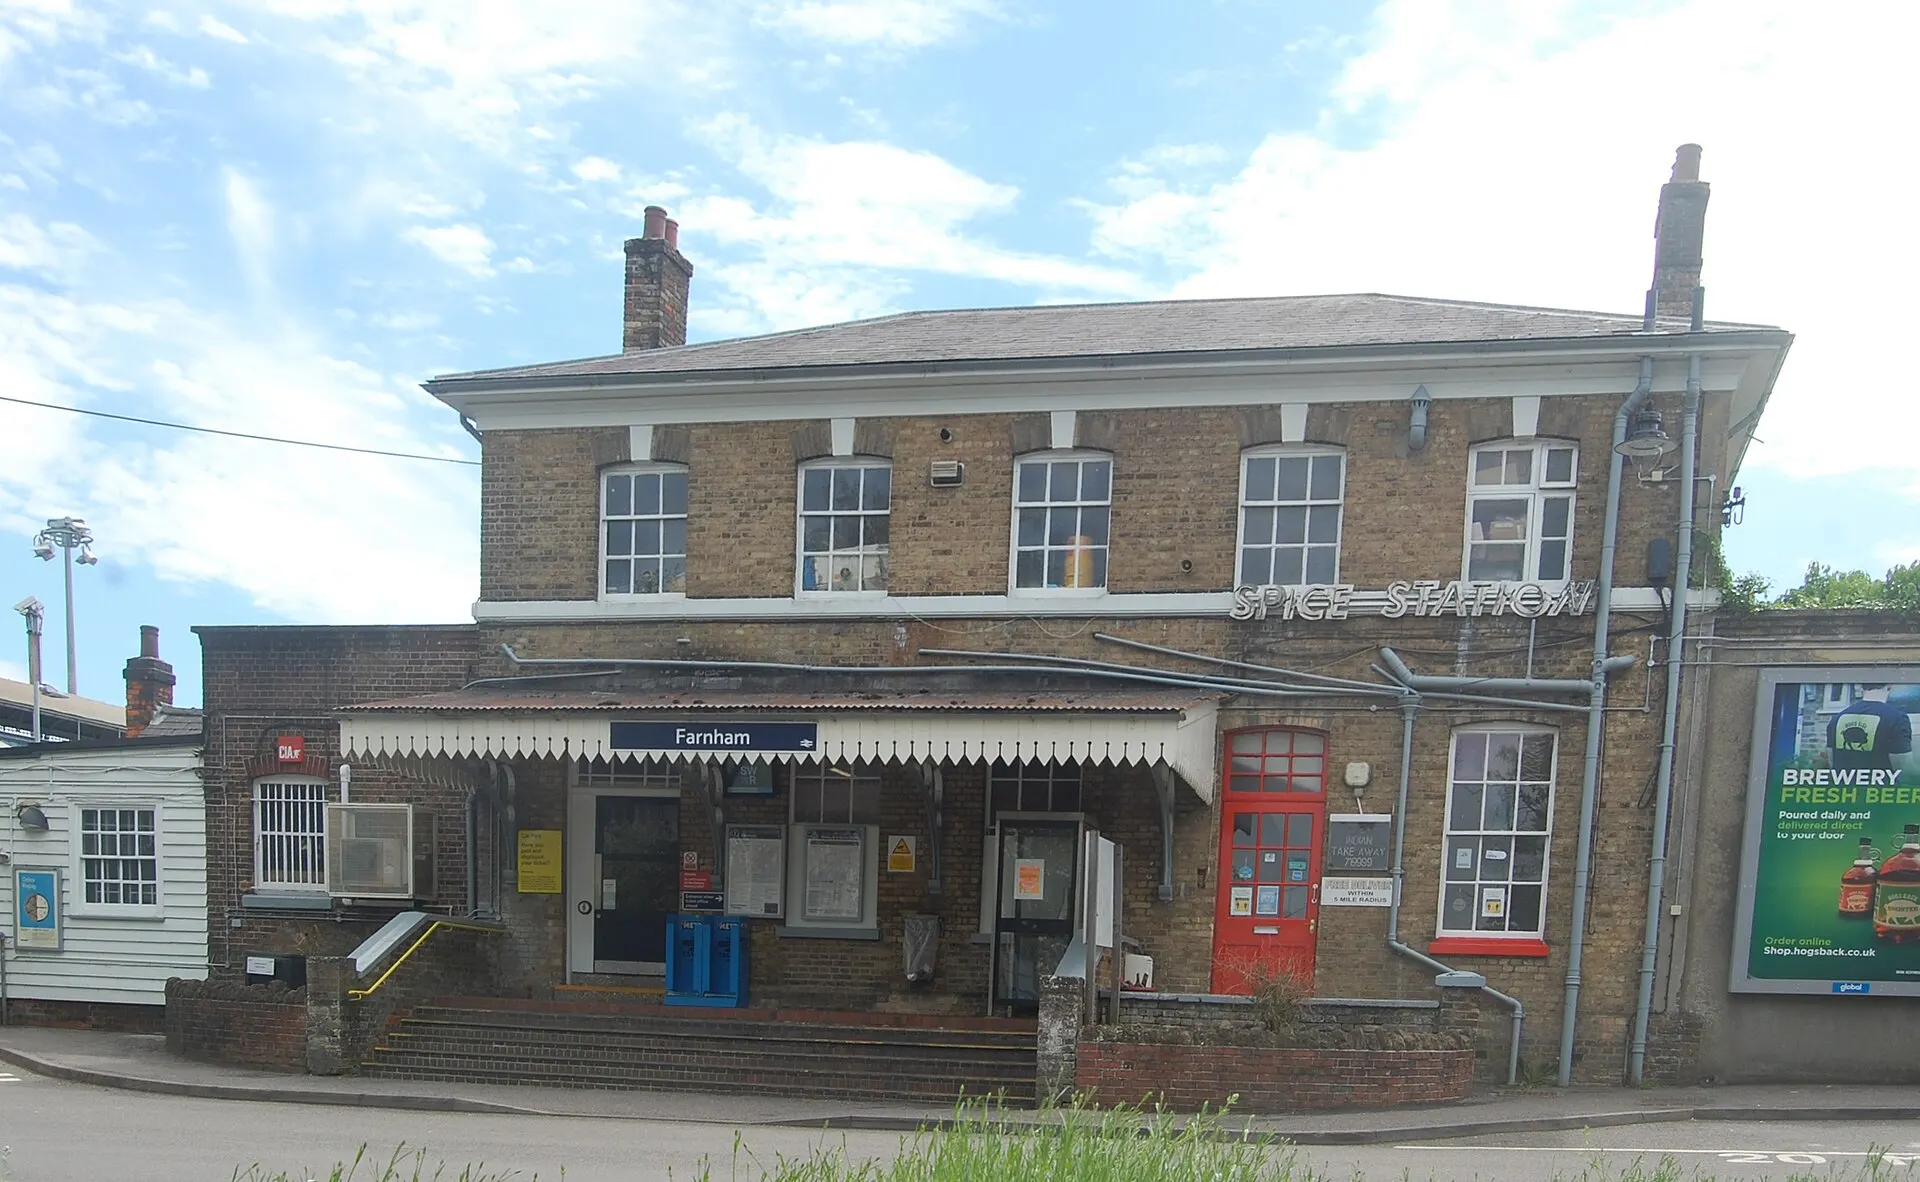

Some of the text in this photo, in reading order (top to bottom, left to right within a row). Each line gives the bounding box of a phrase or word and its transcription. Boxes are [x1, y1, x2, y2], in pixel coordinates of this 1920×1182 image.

[1229, 580, 1595, 621] SPICE STATION
[675, 728, 750, 745] Farnham
[279, 745, 293, 759] CIA
[1782, 769, 1902, 785] BREWERY
[1780, 787, 1858, 804] FRESH
[1779, 811, 1871, 821] Poured daily and
[1778, 821, 1863, 830] delivered direct
[1791, 832, 1816, 841] your
[1818, 832, 1845, 840] door
[1331, 847, 1386, 858] TAKE AWAY
[1351, 880, 1392, 891] DELIVER
[1765, 937, 1831, 946] Order online
[1764, 946, 1876, 957] Shop.hogsback.co.uk
[1840, 983, 1862, 992] global
[1718, 1153, 1827, 1164] 20
